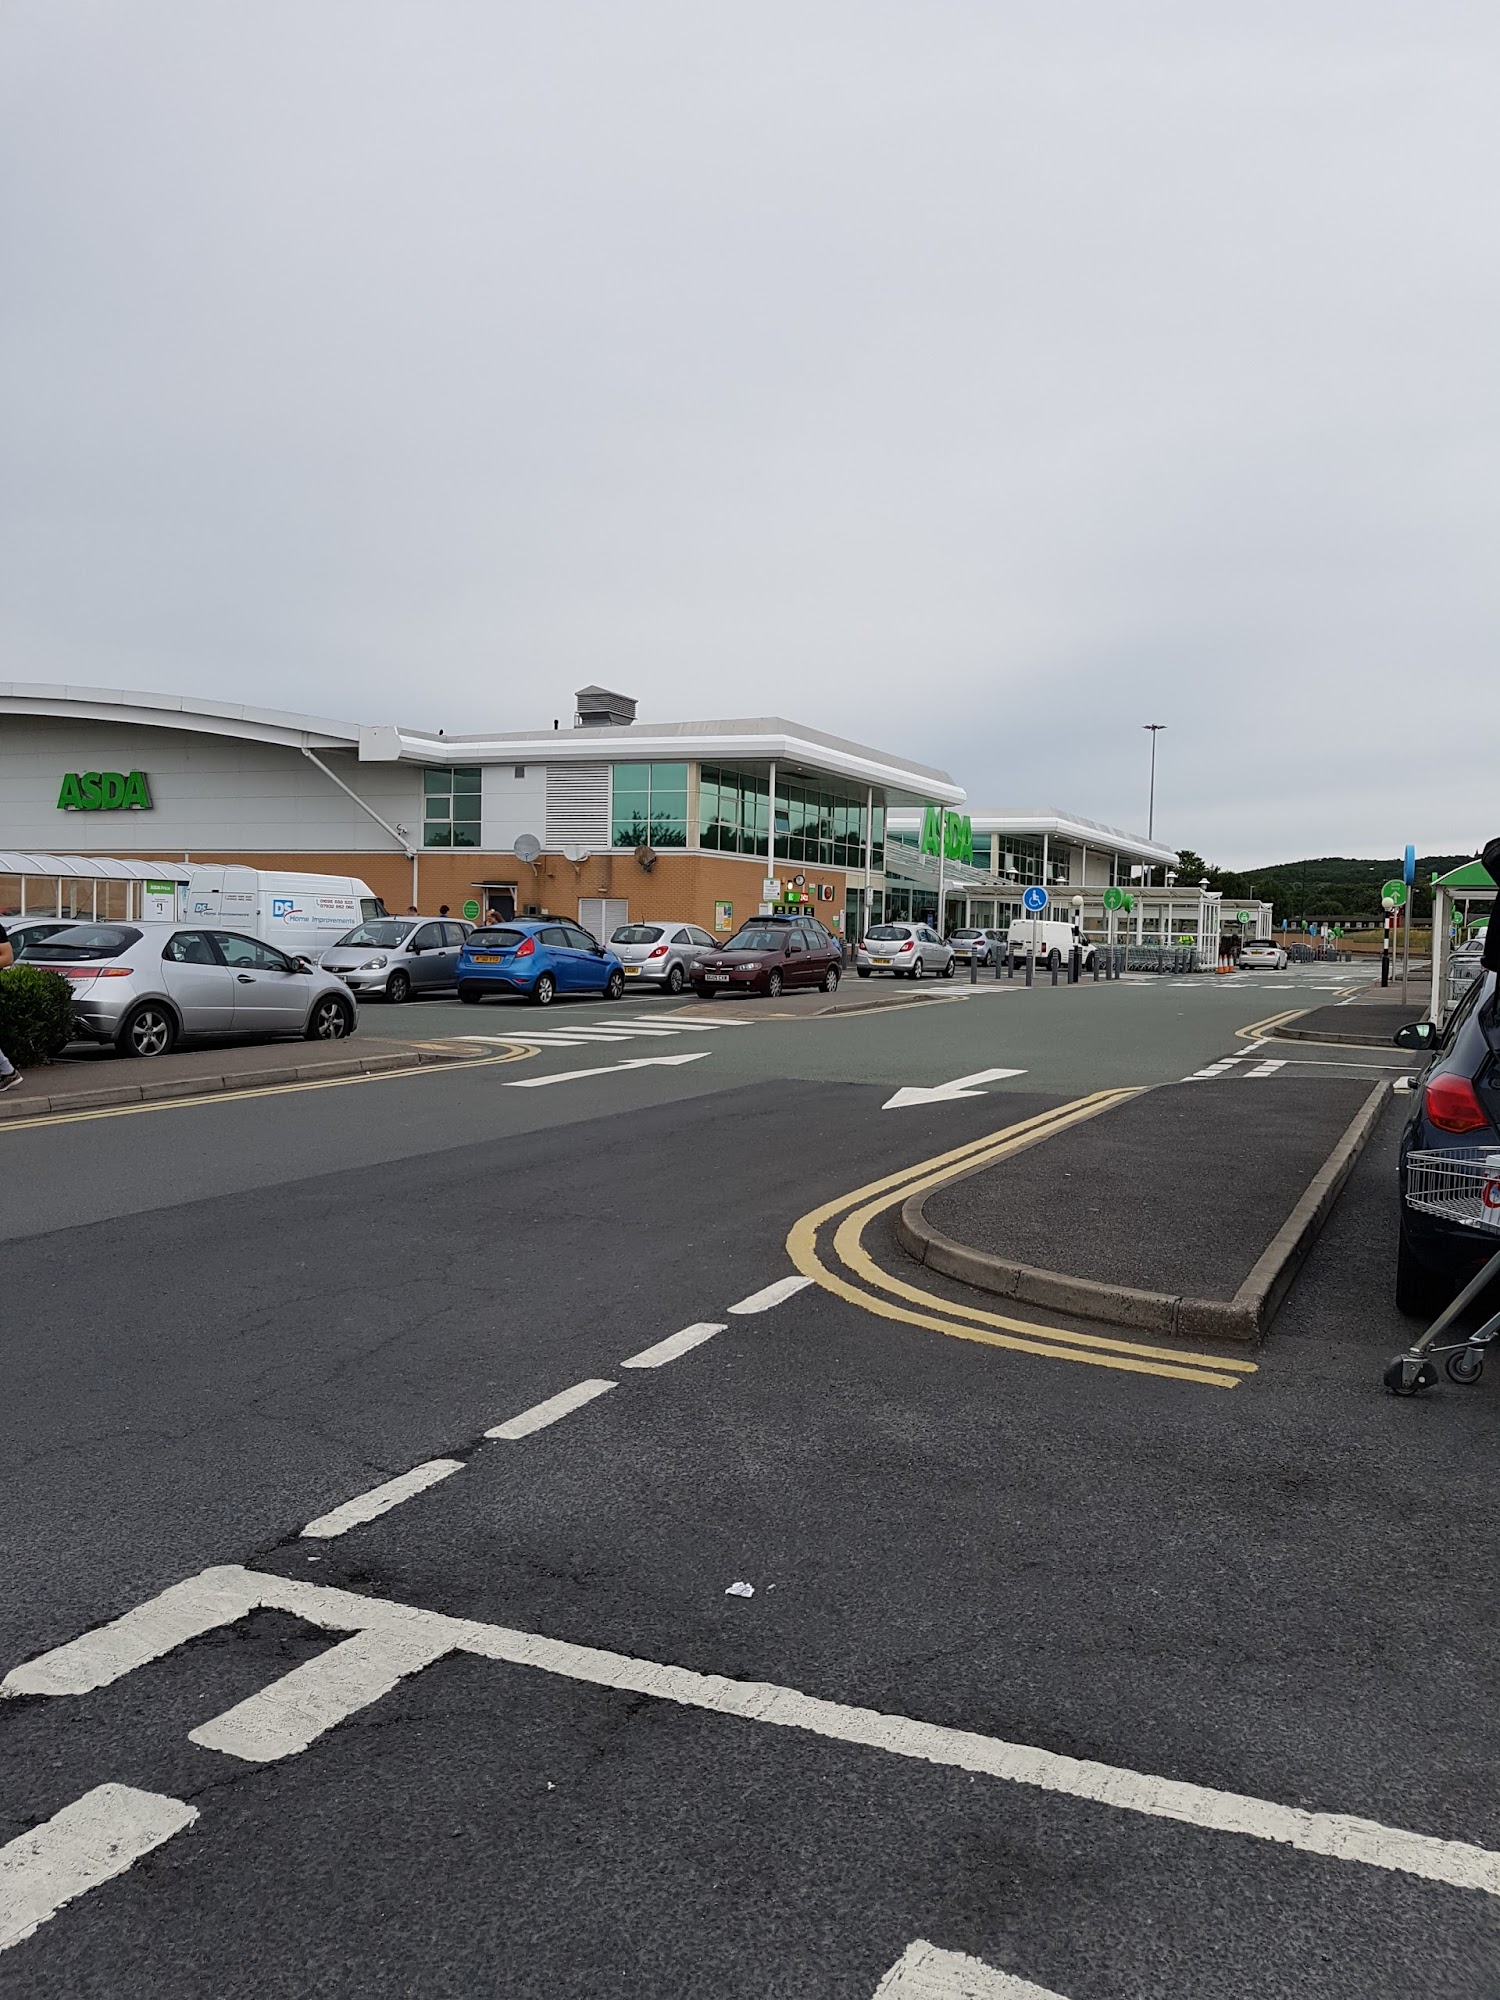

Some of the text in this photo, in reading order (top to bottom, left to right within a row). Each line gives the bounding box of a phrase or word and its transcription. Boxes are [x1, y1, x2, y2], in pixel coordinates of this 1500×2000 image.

[57, 772, 149, 810] ASDA
[275, 902, 293, 916] DS
[312, 916, 355, 925] Improvements
